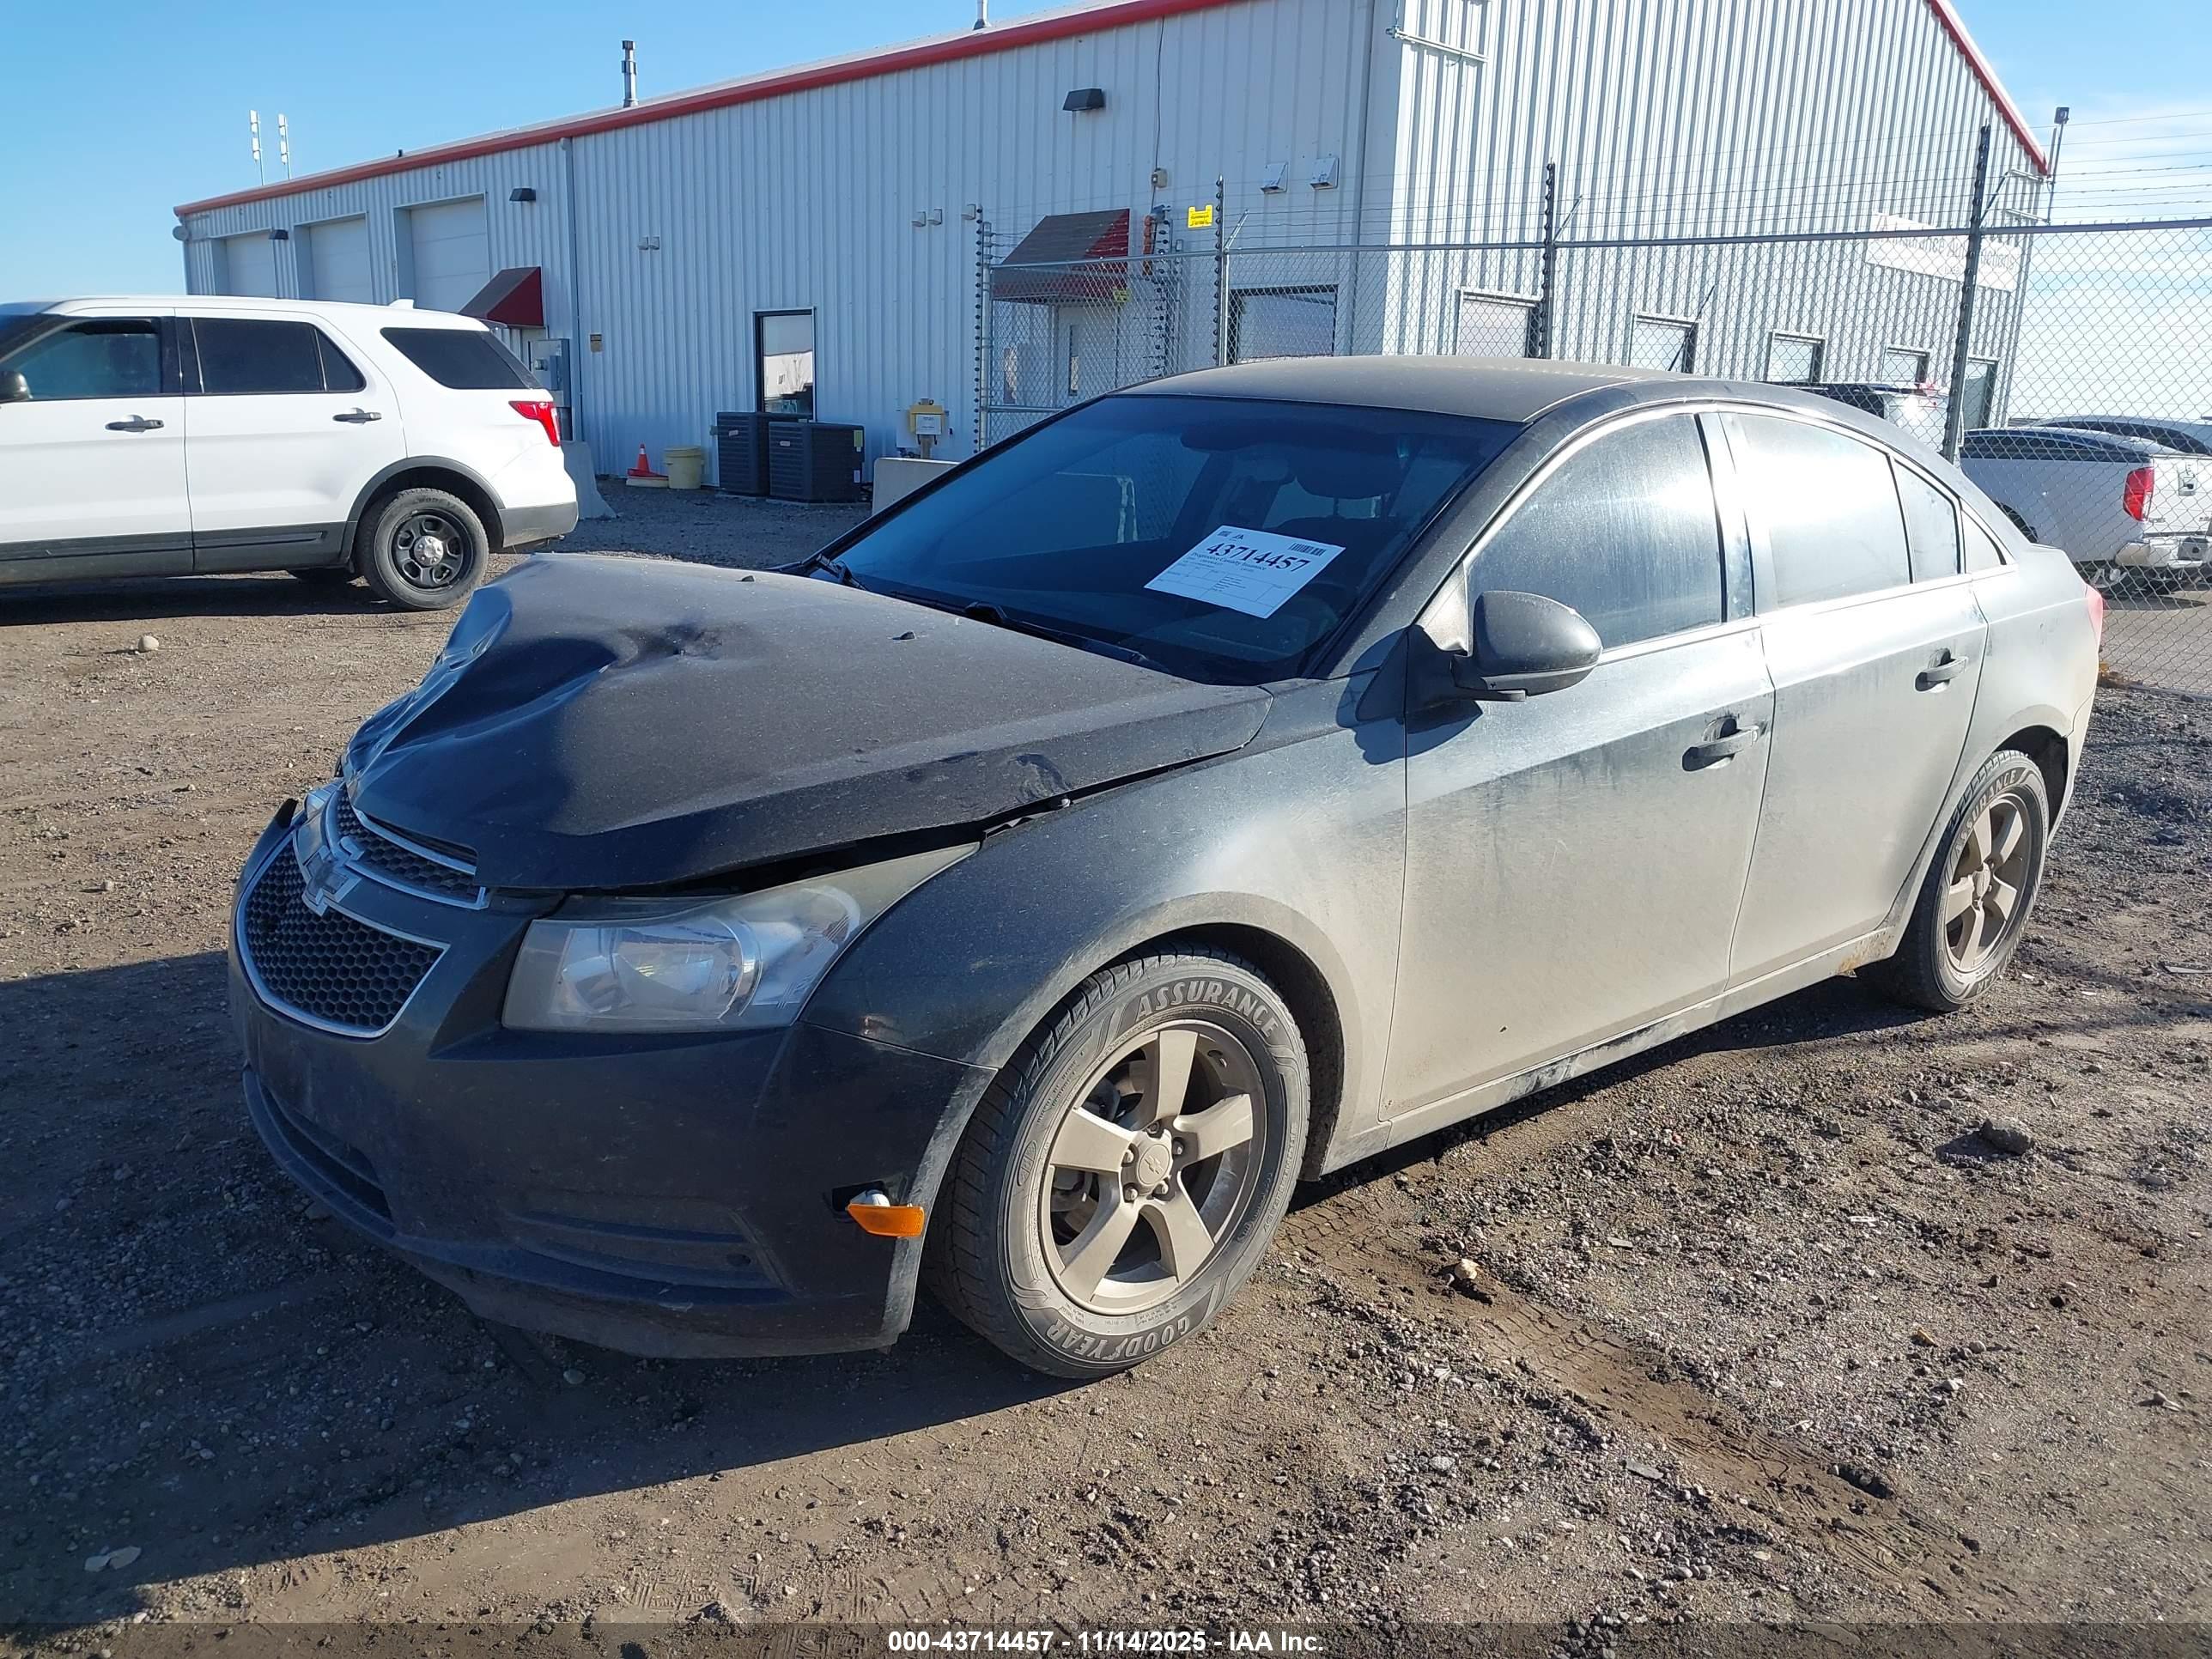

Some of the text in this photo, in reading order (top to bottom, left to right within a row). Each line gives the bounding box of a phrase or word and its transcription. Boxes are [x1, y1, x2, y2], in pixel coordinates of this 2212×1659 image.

[1206, 542, 1311, 572] 43714457
[1955, 769, 2016, 860] ASSURANCE
[1135, 980, 1279, 1038] ASSURANCE
